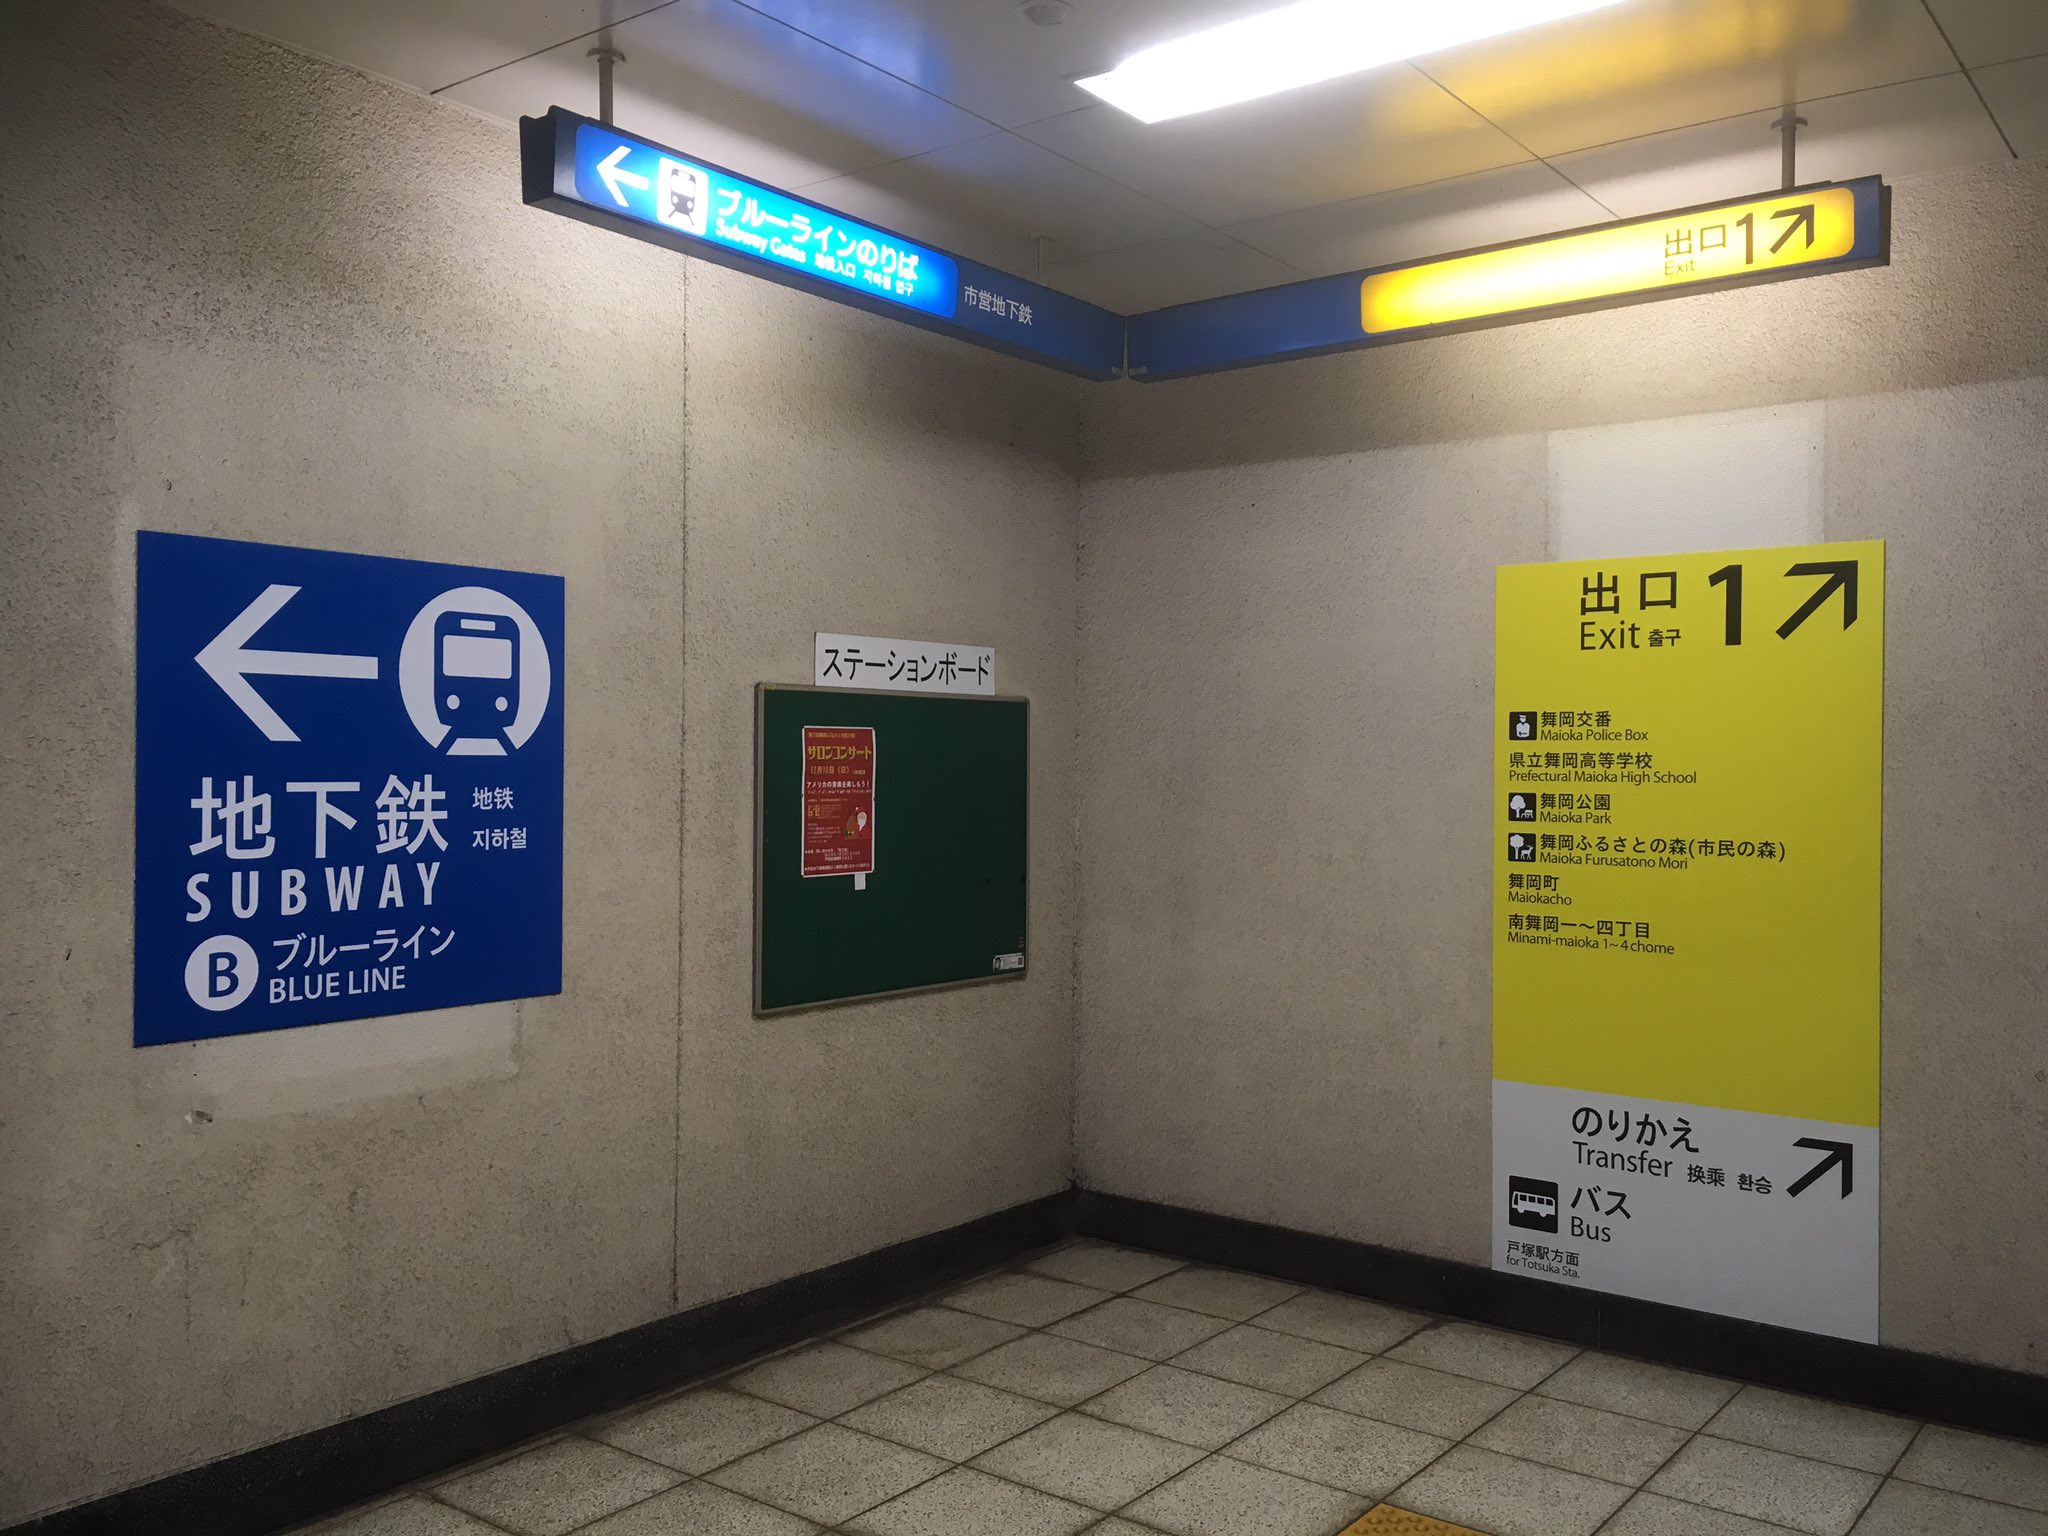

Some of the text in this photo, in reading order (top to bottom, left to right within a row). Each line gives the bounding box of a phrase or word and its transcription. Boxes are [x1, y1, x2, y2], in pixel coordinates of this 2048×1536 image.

[715, 218, 807, 263] Subway Gates
[716, 187, 919, 281] ブルーラインのりば
[1664, 212, 1754, 265] 出口 1
[1664, 259, 1696, 276] Exit
[963, 285, 1033, 327] 市営地下鉄
[1580, 564, 1742, 646] 出口 1
[1580, 620, 1640, 651] Exit
[1648, 628, 1681, 647] 출구
[822, 647, 991, 686] ステーションボード
[1541, 710, 1611, 728] 舞岡交番
[1540, 728, 1648, 741] Maioka Police Box
[808, 745, 872, 760] サロンコンサート
[1509, 751, 1653, 770] 県立舞岡高等学校
[1509, 769, 1696, 786] Prefectural Maioka High School
[472, 786, 514, 811] 地铁
[1540, 792, 1611, 811] 舞岡公園
[188, 774, 449, 859] 地下鉄
[1539, 811, 1611, 824] Maioka Park
[472, 827, 527, 850] 지하철
[1540, 833, 1786, 863] 舞岡ふるさとの森(市民の森)
[1539, 851, 1688, 870] Maioka Furusatono Mori
[186, 861, 442, 922] SUBWAY
[1508, 873, 1559, 892] 舞岡町
[1508, 891, 1572, 906] Maiokacho
[272, 924, 456, 971] ブルーライン
[1508, 931, 1599, 949] Minami-maioka
[1631, 938, 1675, 955] chome
[207, 952, 239, 998] B
[269, 966, 406, 1004] BLUE LINE
[1572, 1106, 1699, 1152] のりかえ
[1573, 1141, 1672, 1177] Transfer
[1737, 1173, 1772, 1194] 환승
[1570, 1185, 1632, 1220] バス
[1570, 1217, 1612, 1242] Bus
[1507, 1240, 1579, 1267] 戸塚駅方面
[1506, 1255, 1580, 1279] for Totsuka Sta.
